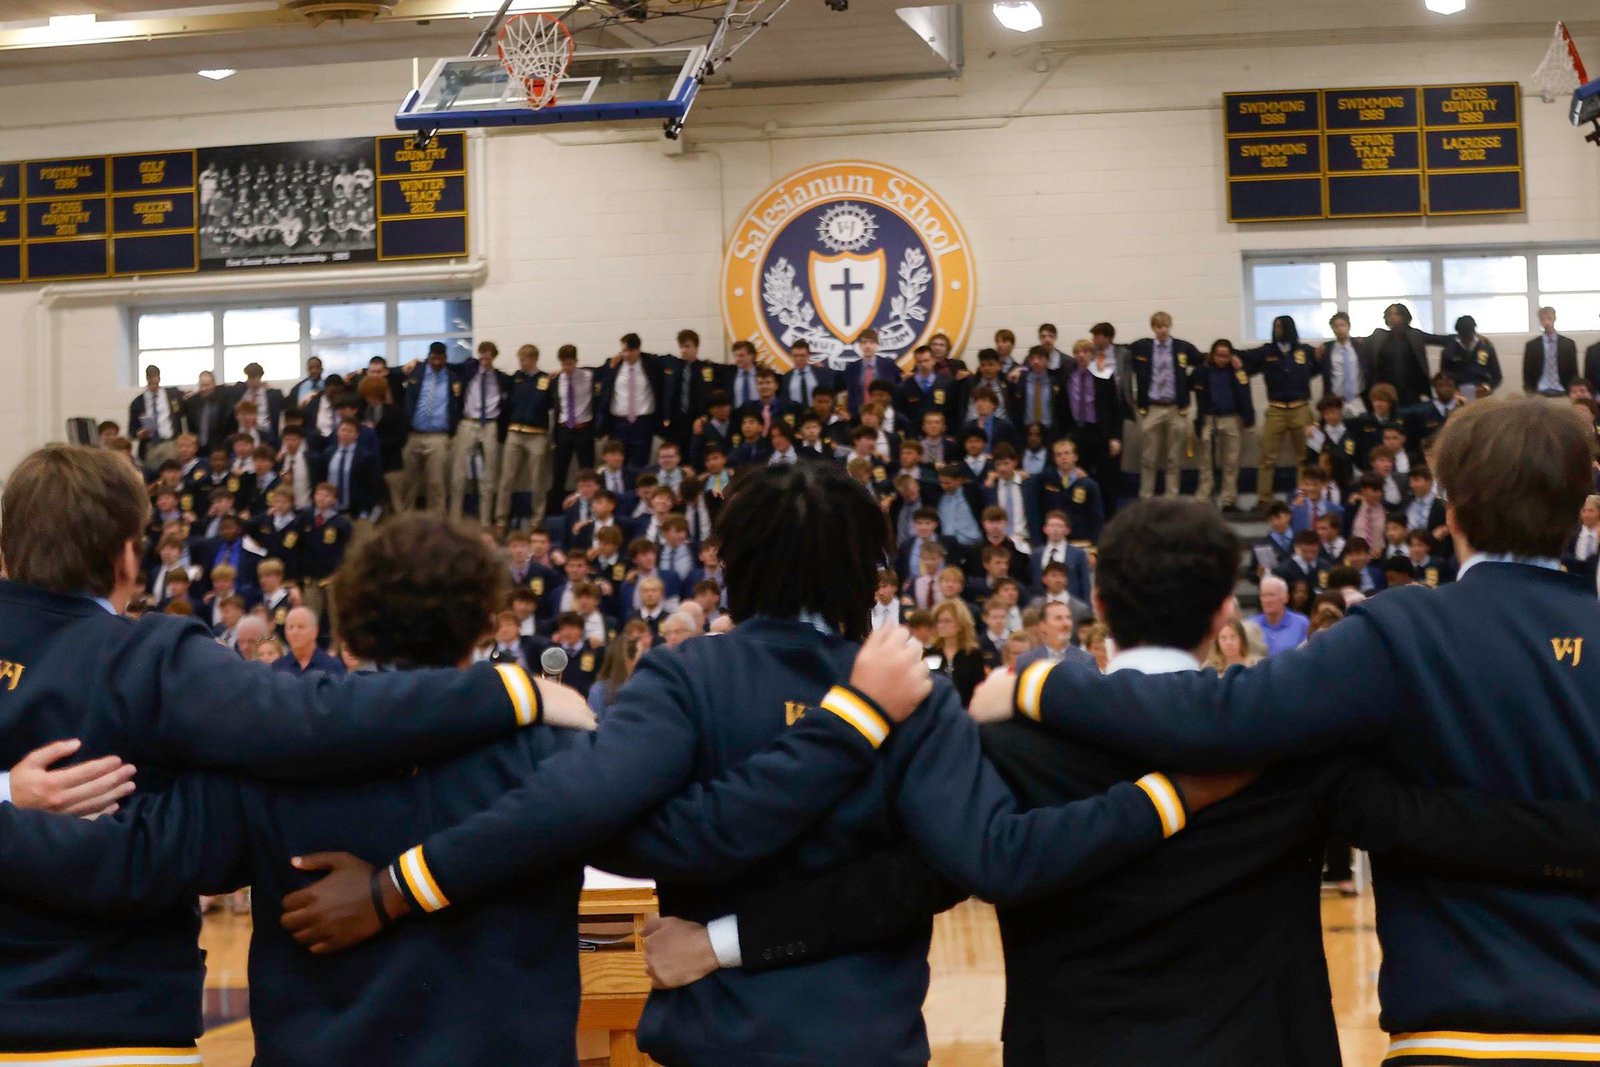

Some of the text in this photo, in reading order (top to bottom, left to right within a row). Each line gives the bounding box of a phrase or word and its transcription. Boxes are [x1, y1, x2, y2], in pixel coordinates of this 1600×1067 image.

[1450, 88, 1488, 101] CROSS
[1239, 100, 1306, 114] SWIMMING
[1337, 96, 1404, 110] SWIMMING
[1441, 99, 1497, 112] COUNTRY
[1350, 134, 1394, 147] SPRING
[1442, 136, 1502, 150] LACROSSE
[395, 147, 448, 162] COUNTRY
[1240, 143, 1308, 157] SWIMMING
[1354, 146, 1396, 158] TRACK
[39, 165, 93, 180] FOOTBALL
[138, 160, 166, 173] GOLF
[399, 178, 446, 192] WINTER
[403, 190, 441, 203] TRACK
[132, 200, 173, 214] SOCCER
[41, 211, 91, 226] COUNTRY
[732, 174, 962, 264] Salesianum School
